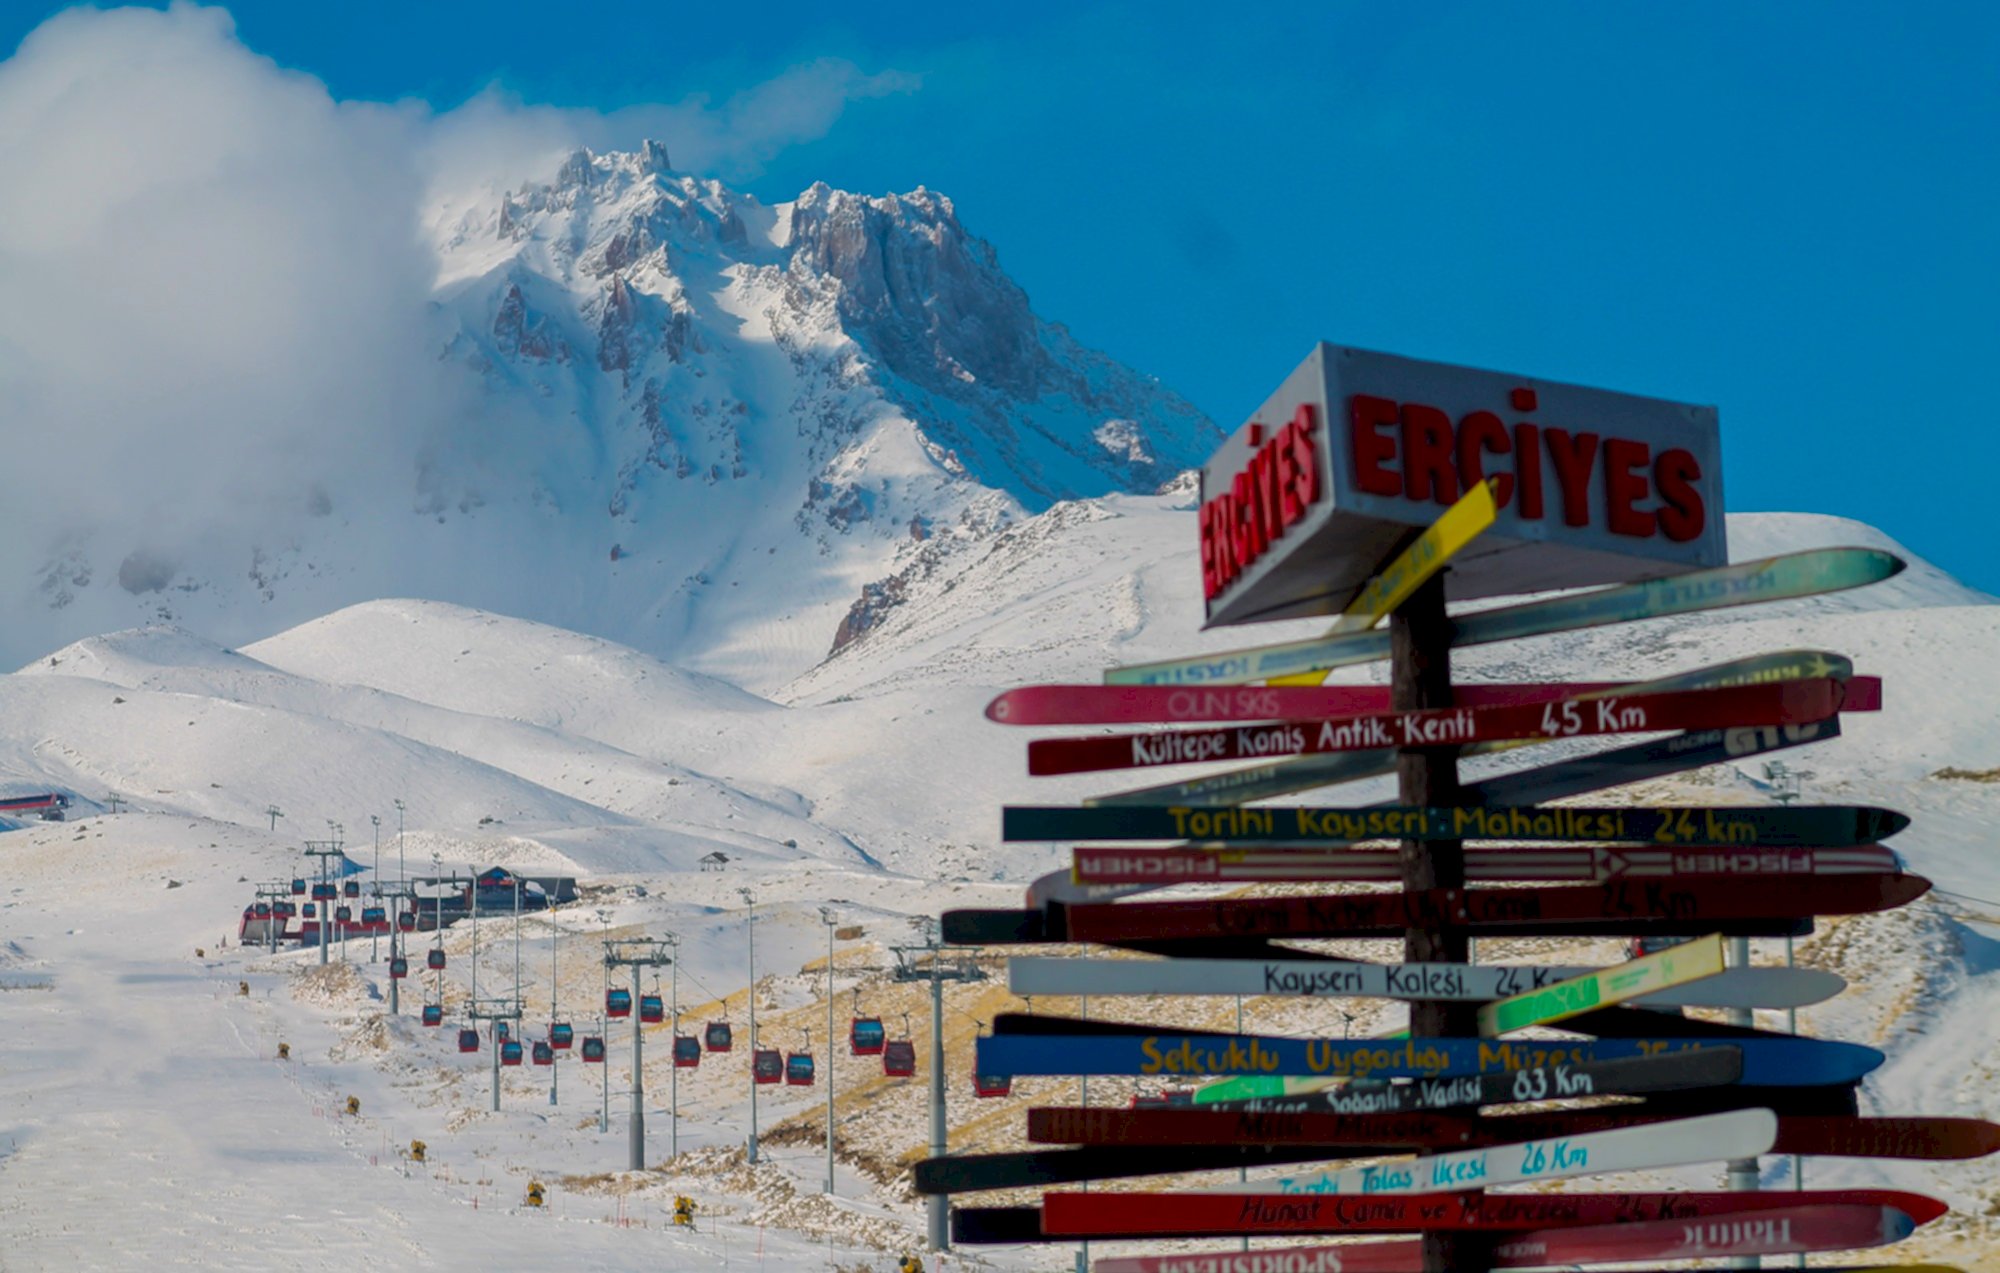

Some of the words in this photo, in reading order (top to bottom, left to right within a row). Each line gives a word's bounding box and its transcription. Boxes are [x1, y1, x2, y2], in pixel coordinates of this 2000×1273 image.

[1132, 733, 1227, 766] Kültepe
[1403, 710, 1476, 744] Kenti
[1540, 700, 1583, 737] 45
[1596, 698, 1647, 732] Km
[1295, 806, 1428, 840] Kayseri
[1653, 807, 1698, 843] 24
[1704, 807, 1759, 843] km
[1081, 856, 1217, 877] FISCHER
[1676, 854, 1812, 874] FISCHER
[1264, 964, 1363, 995] Kayseri
[1495, 966, 1523, 996] 24
[1532, 966, 1563, 989] K
[1420, 1075, 1482, 1109] Vadisi
[1554, 1065, 1593, 1094] Km
[1359, 1164, 1413, 1195] Talas
[1520, 1141, 1546, 1175] 26
[1550, 1139, 1589, 1171] Km
[1419, 1203, 1449, 1220] ve
